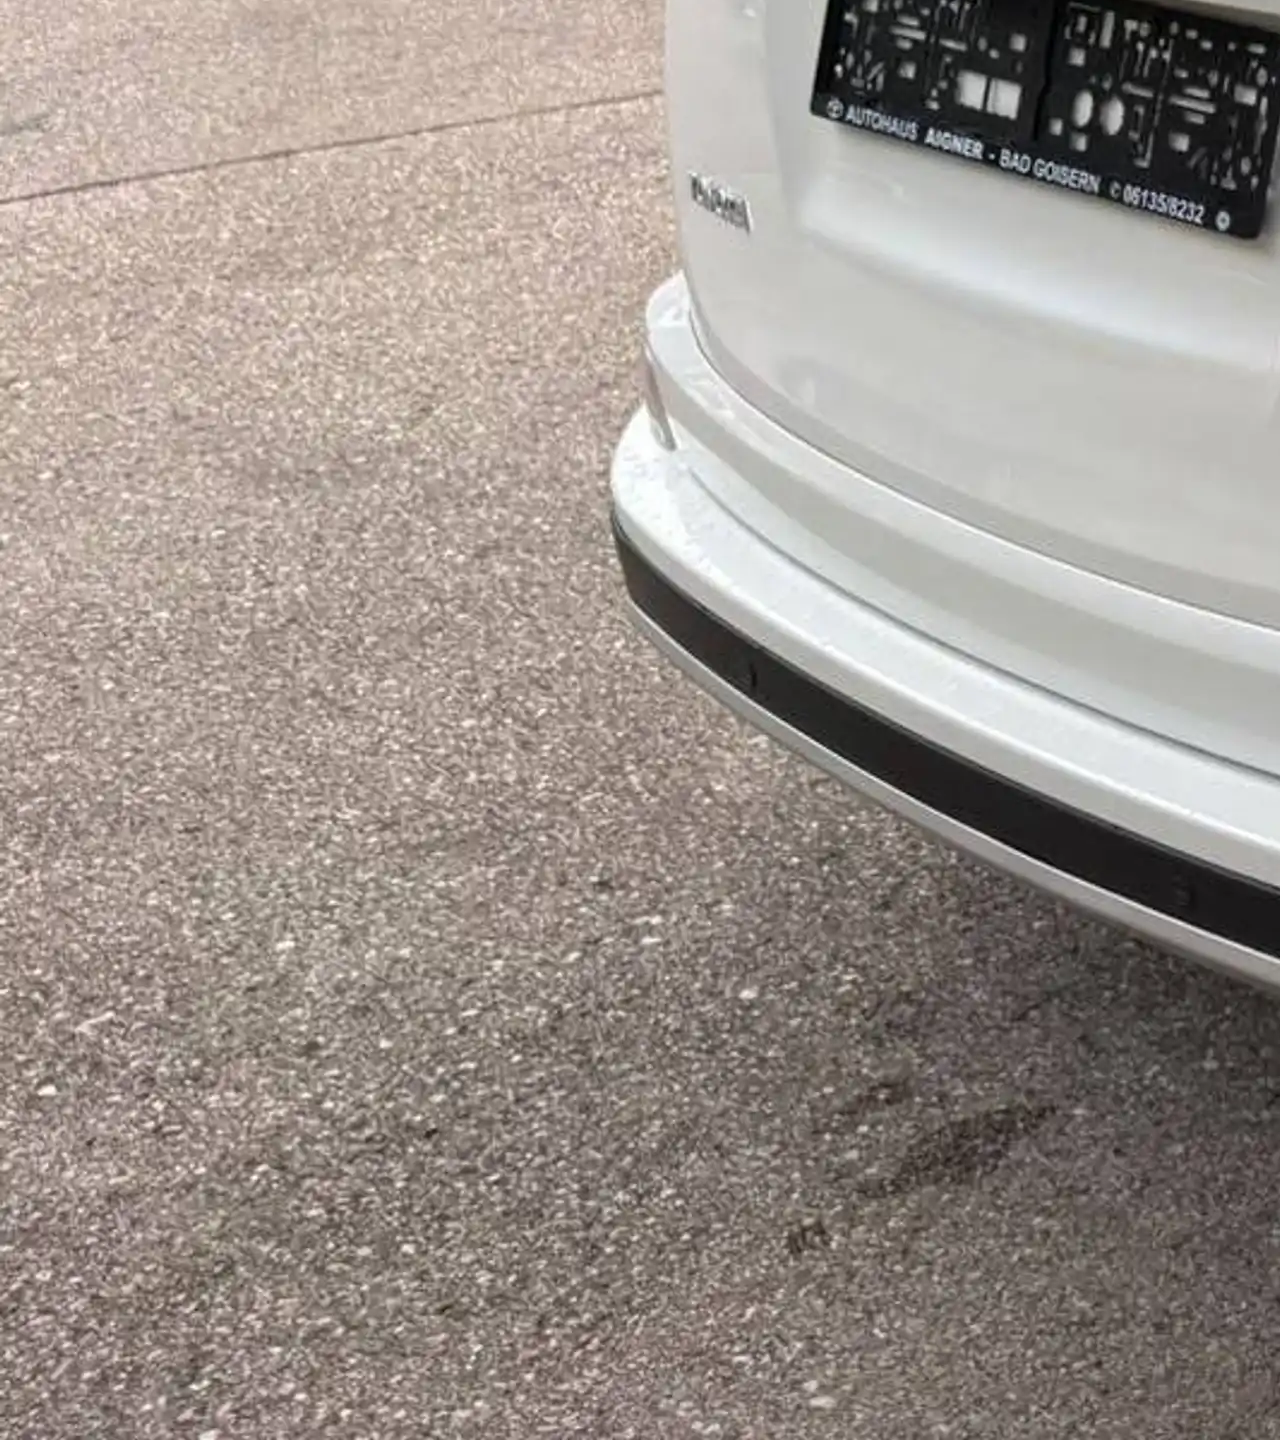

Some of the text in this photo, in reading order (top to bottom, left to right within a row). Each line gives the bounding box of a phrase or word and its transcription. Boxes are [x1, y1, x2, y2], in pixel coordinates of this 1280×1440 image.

[845, 103, 920, 141] AUTOHAUS
[924, 127, 984, 160] AIGNER
[999, 148, 1031, 174] BAD
[1033, 157, 1101, 195] GOISERN
